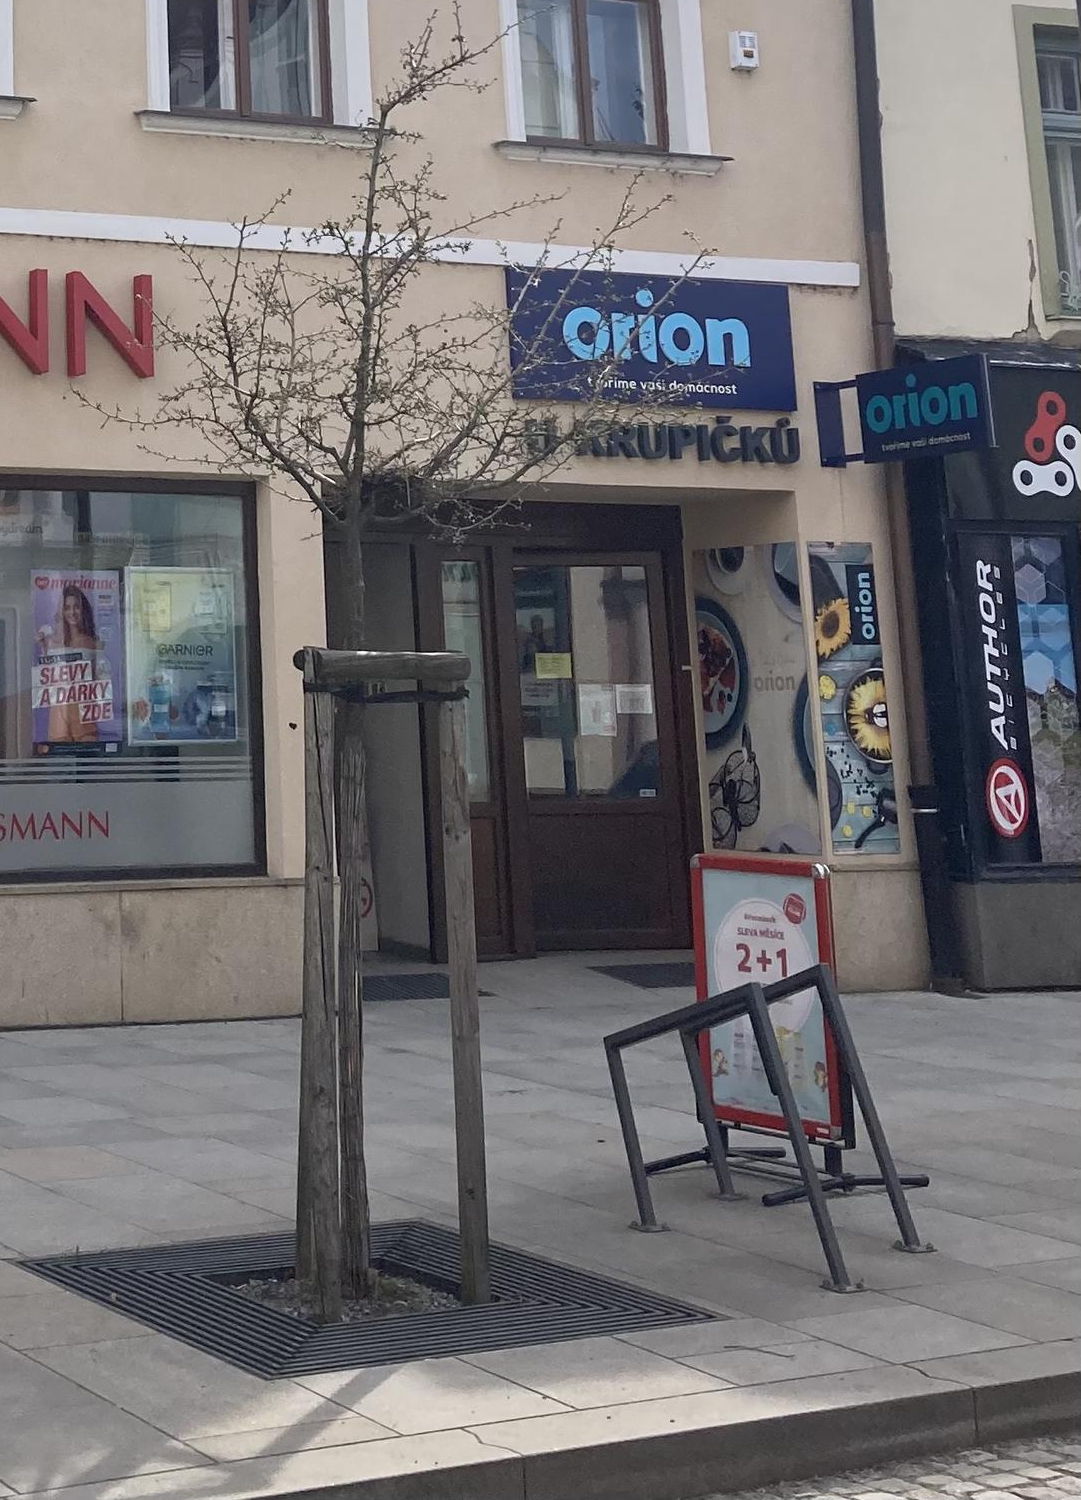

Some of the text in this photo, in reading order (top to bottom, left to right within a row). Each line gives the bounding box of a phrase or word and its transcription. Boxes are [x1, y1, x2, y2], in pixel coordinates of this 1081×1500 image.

[563, 288, 751, 368] orion
[669, 380, 738, 395] domácnost
[866, 373, 978, 434] orion
[854, 572, 876, 641] orion
[157, 643, 214, 657] GARNIER
[976, 559, 1009, 751] AUTHOR
[40, 662, 88, 686] SLEVY
[754, 669, 796, 692] orion
[39, 681, 110, 707] A DÁRKY
[81, 702, 112, 724] ZDE
[737, 926, 759, 938] SLEVA
